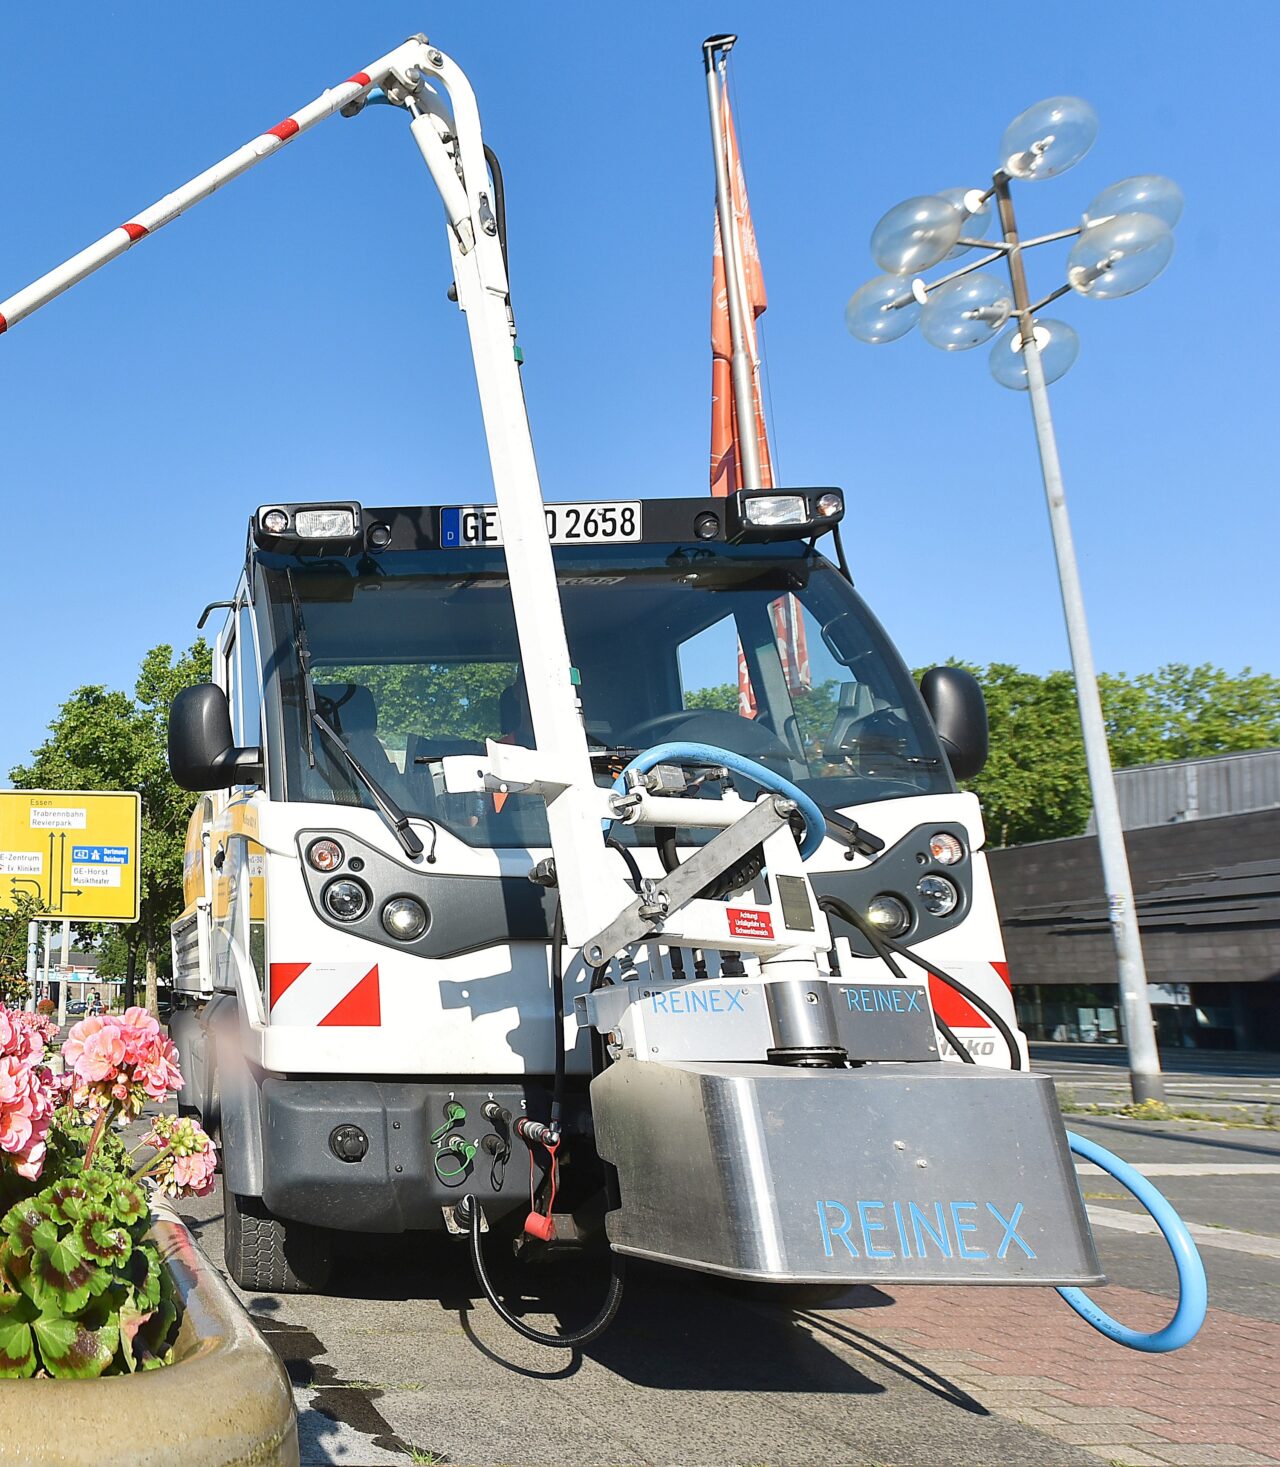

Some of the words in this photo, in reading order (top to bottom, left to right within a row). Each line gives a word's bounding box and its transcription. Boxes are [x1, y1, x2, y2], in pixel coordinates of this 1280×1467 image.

[462, 511, 498, 541] GE
[565, 507, 635, 538] 2658
[447, 531, 454, 540] D
[33, 810, 84, 818] Trabrennbahn
[32, 819, 72, 827] Revierpark
[103, 856, 125, 864] Duisburg
[73, 867, 108, 875] GE-Horst
[73, 877, 109, 885] Musiktheater
[651, 989, 744, 1013] REINEX
[846, 989, 921, 1013] REINEX
[816, 1200, 1037, 1259] REINEX
